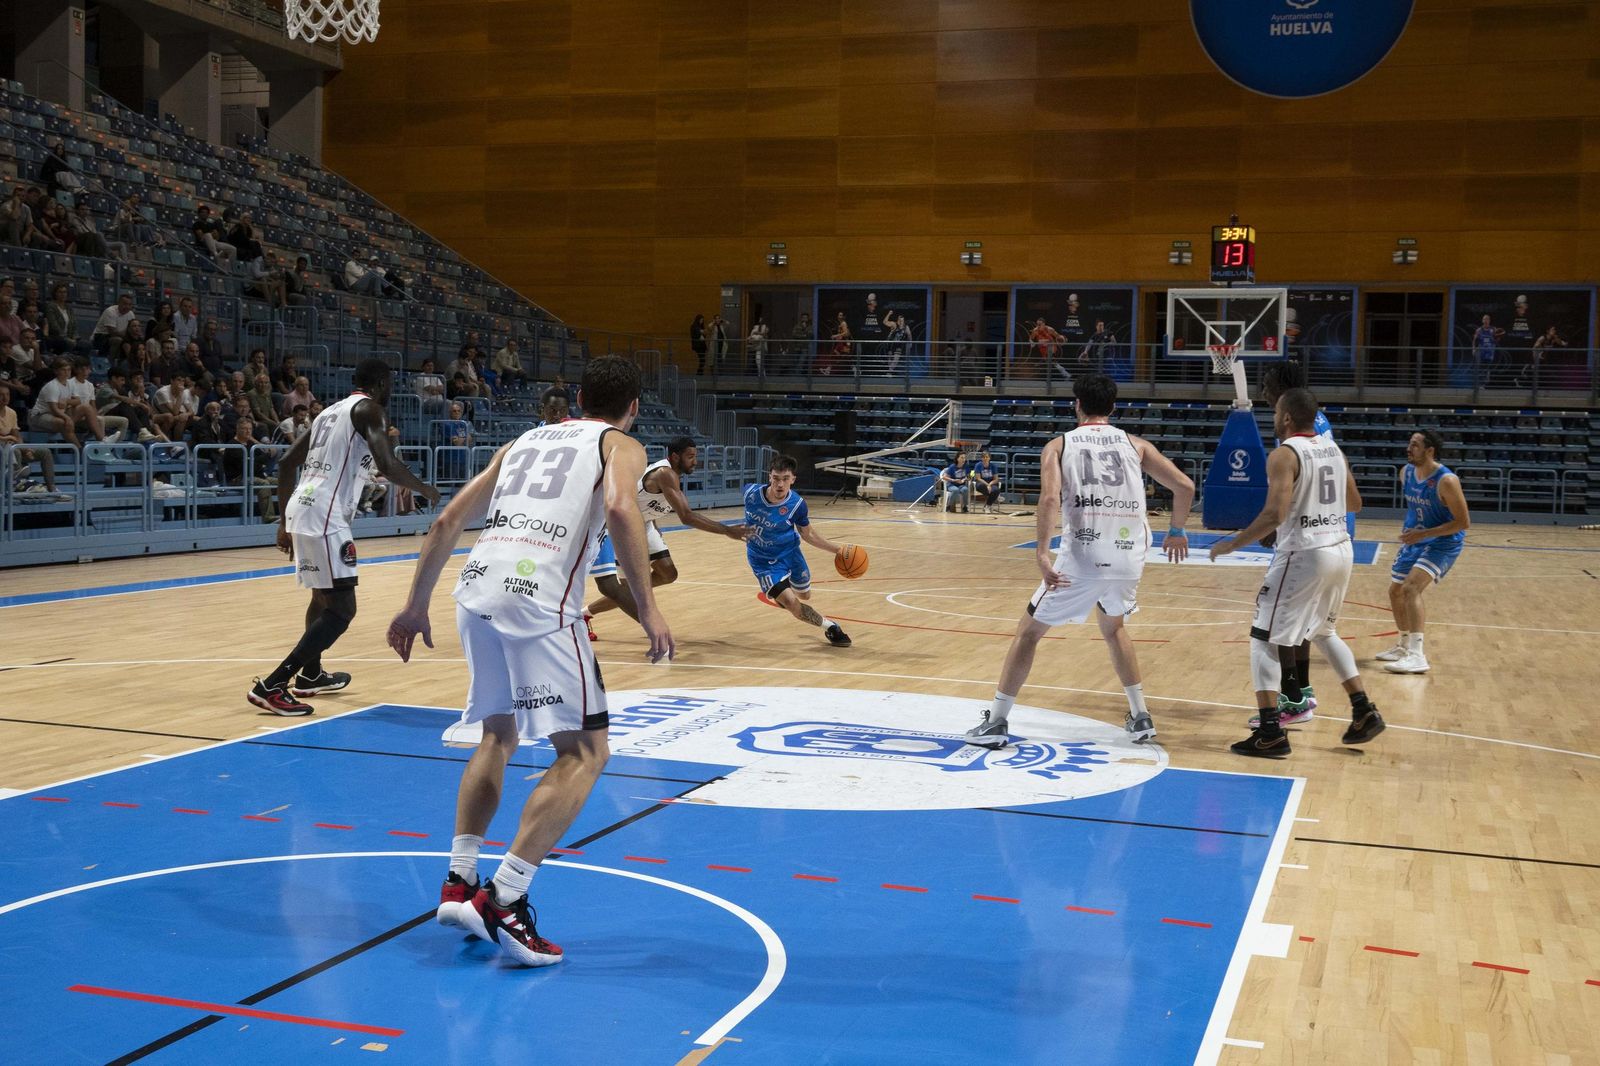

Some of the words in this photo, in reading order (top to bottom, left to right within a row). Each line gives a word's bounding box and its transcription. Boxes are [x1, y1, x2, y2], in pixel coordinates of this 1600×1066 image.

[1271, 12, 1322, 22] Ayuntamiento
[1324, 11, 1334, 19] de
[1270, 22, 1333, 36] HUELVA
[1221, 227, 1247, 240] 3:34
[1224, 243, 1244, 265] 13
[494, 447, 579, 500] 33
[1080, 448, 1124, 487] 13
[1319, 465, 1336, 504] 6
[486, 509, 567, 541] eleGroup
[516, 536, 561, 552] CHALLENGES
[503, 577, 539, 591] ALTUNA
[505, 585, 510, 593] Y
[512, 586, 534, 598] URIA
[633, 701, 767, 748] Ayuntamiento
[815, 749, 907, 760] CUSTODIA
